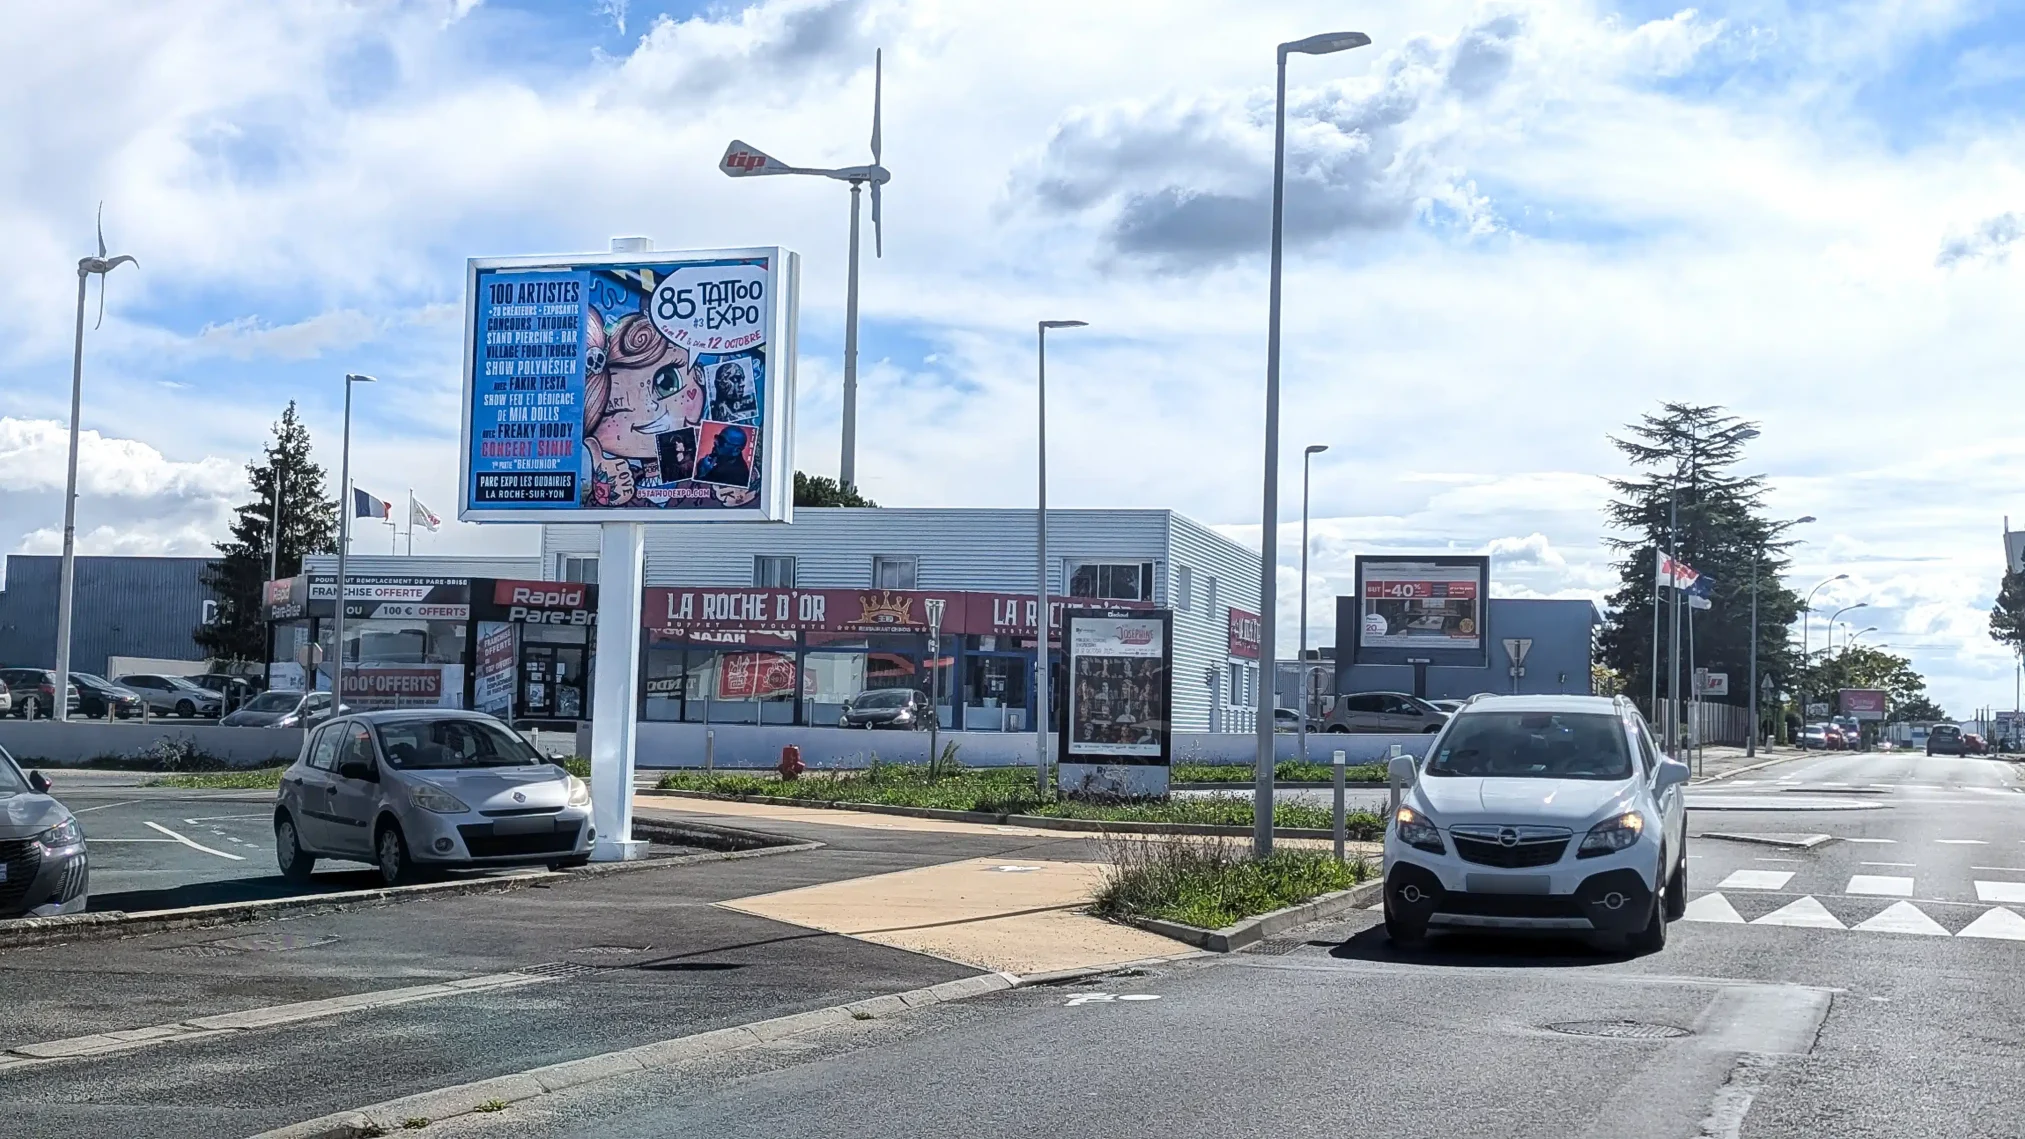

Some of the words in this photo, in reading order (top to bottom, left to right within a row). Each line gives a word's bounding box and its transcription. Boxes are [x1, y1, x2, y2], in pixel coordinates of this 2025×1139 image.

[727, 152, 766, 172] tip
[490, 283, 513, 304] 100
[518, 282, 579, 304] ARTISTES
[502, 304, 537, 316] CRÉATEURS
[543, 304, 579, 315] EXPOSANTS
[657, 286, 696, 320] 85
[488, 317, 532, 331] CONCOURS
[537, 316, 578, 330] TATOUAGE
[707, 304, 759, 330] EXPO
[487, 332, 512, 344] STAND
[515, 331, 554, 344] PIERCING
[561, 330, 578, 343] BAR
[675, 329, 688, 341] 11
[707, 336, 722, 349] 12
[724, 330, 762, 349] OCTOBRE
[486, 345, 519, 359] VILLAGE
[521, 344, 542, 358] FOOD
[545, 343, 577, 358] TRUCKS
[486, 361, 514, 376] SHOW
[518, 358, 576, 375] POLYNÉSIEN
[510, 376, 537, 390] FAKIR
[540, 376, 566, 390] TESTA
[484, 394, 507, 406] SHOW
[510, 393, 523, 406] FEU
[526, 393, 535, 405] ET
[537, 392, 575, 405] DÉDICACE
[609, 397, 624, 409] ART
[497, 410, 507, 421] DE
[509, 407, 528, 421] MIA
[531, 406, 560, 421] DOLLS
[497, 423, 536, 438] FREAKY
[540, 422, 573, 438] HOODY
[482, 441, 532, 457] CONCERT
[538, 440, 572, 457] SINIK
[480, 476, 499, 487] PARC
[500, 476, 518, 487] EXPO
[520, 476, 532, 487] LES
[534, 475, 571, 487] OUDAIRIES
[615, 461, 633, 496] LOVE
[485, 490, 496, 498] LA
[498, 490, 565, 499] ROCHE-SUR-YON
[356, 577, 412, 585] REMPLACEMENT
[375, 587, 423, 597] OFFERTE
[513, 587, 581, 607] Rapid
[1384, 583, 1422, 597] -40%
[346, 606, 363, 615] OU
[383, 606, 402, 615] 100
[404, 607, 413, 616] €
[667, 592, 694, 619] LA
[702, 592, 769, 620] ROCHE
[775, 591, 826, 622] D'OR
[994, 599, 1019, 626] LA
[1366, 624, 1378, 632] 20
[484, 628, 511, 648] FRANCHISE
[484, 637, 512, 657] OFFERTE
[342, 675, 375, 691] 100€
